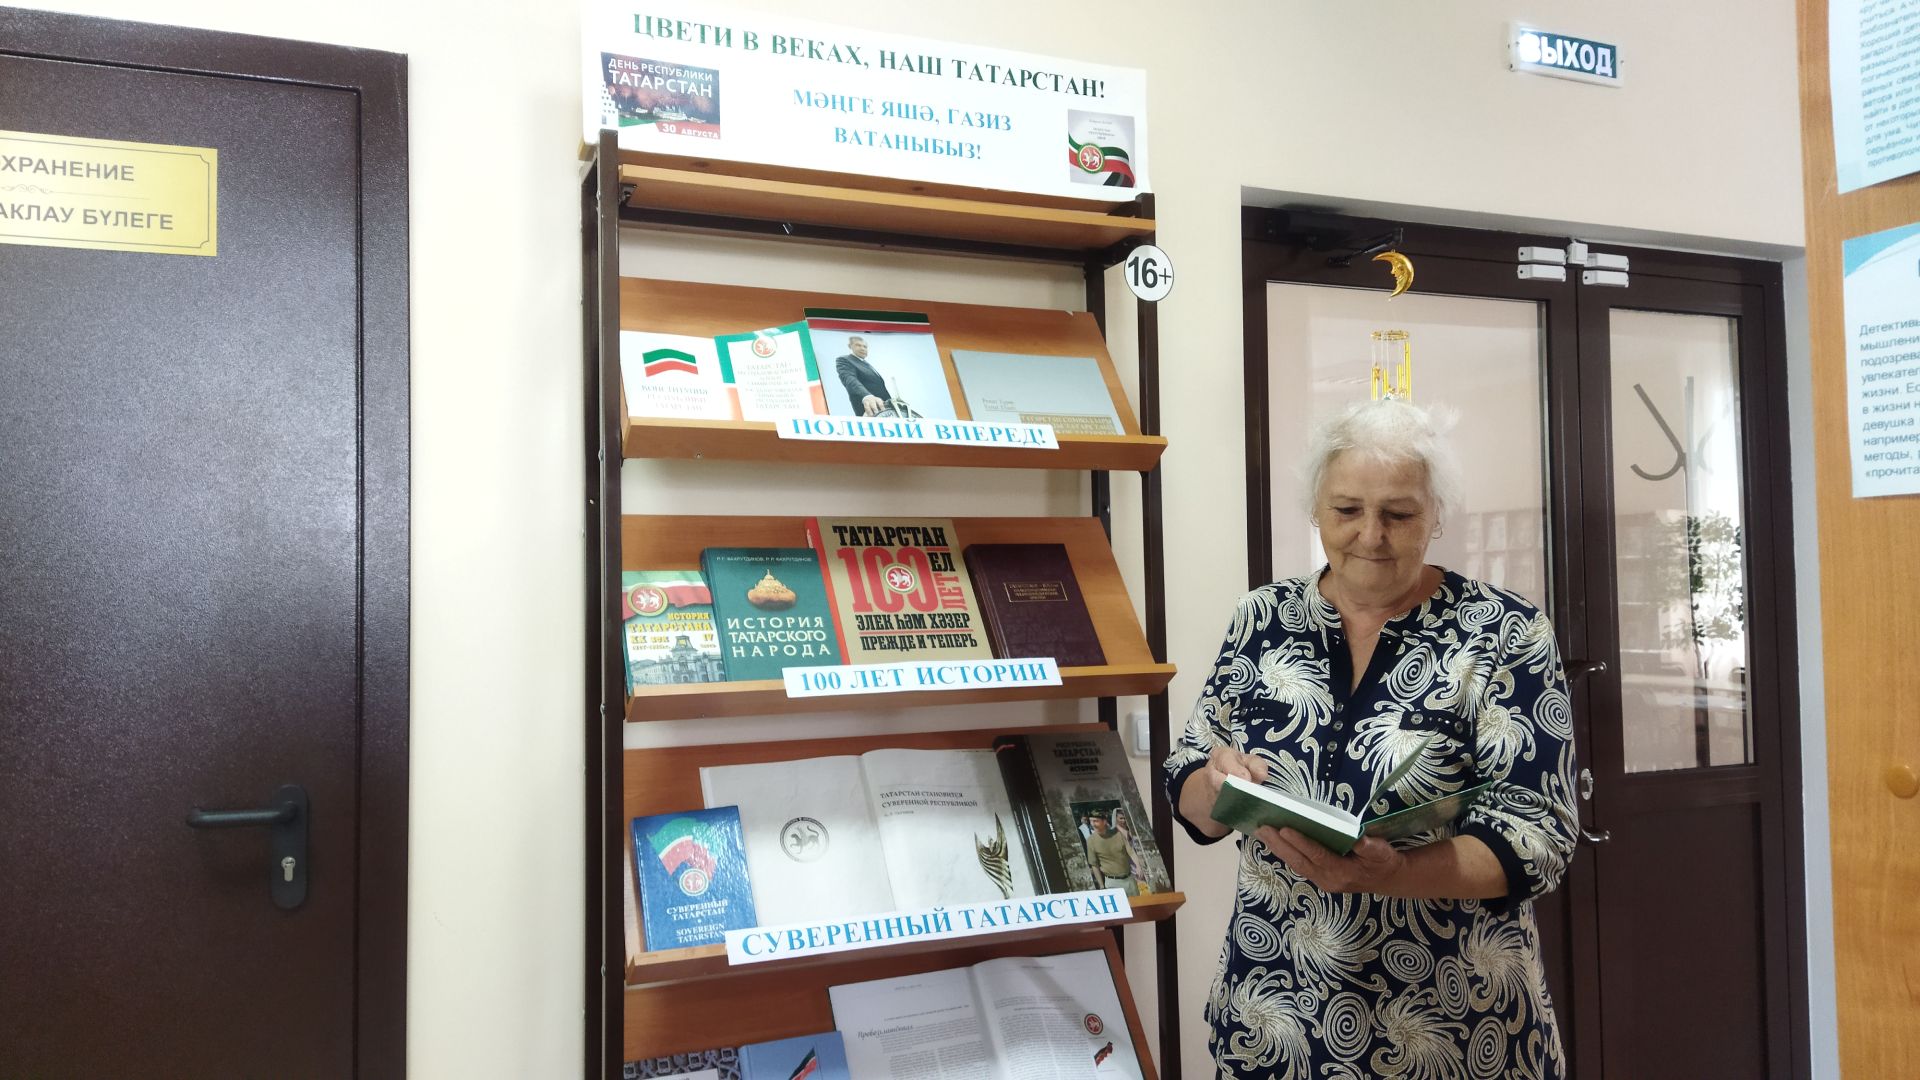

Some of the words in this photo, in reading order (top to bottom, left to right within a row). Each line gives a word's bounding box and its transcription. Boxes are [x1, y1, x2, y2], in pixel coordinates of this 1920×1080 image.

[633, 13, 733, 49] ЦВЕТИ
[743, 30, 760, 51] В
[771, 35, 870, 70] ВЕКАХ,
[879, 50, 942, 78] НАШ
[951, 59, 1106, 99] ТАТАРСТАН!
[1519, 32, 1613, 77] ВЫХОД
[608, 58, 639, 70] ДЕНЬ
[641, 63, 713, 82] РЕСПУБЛИКИ
[608, 69, 712, 98] ТАТАРСТАН
[793, 88, 874, 117] МӘҢГЕ
[881, 101, 941, 126] ЯШӘ,
[947, 107, 1013, 132] ГАЗИЗ
[662, 123, 676, 133] 30
[681, 128, 719, 139] АВГУСТА
[834, 126, 982, 161] ВАТАНЫБЫЗ!
[82, 208, 174, 231] БҮЛЕГЕ
[1127, 256, 1172, 289] 16+
[1860, 336, 1920, 351] мышлени
[1862, 406, 1869, 414] в
[1873, 401, 1911, 413] жизни
[792, 417, 924, 440] ПОЛНЫЙ
[935, 423, 1048, 446] ВПЕРЕД!
[1862, 417, 1915, 432] девушка
[832, 524, 949, 547] ТАТАРСТАН
[930, 552, 956, 572] ЕЛ
[837, 547, 942, 614] 100
[933, 573, 968, 611] ЛЕТ
[667, 612, 711, 620] ИСТОРИЯ
[727, 616, 824, 629] ИСТОРИЯ
[855, 614, 892, 631] ЭЛЕК
[896, 613, 927, 630] ҺӘМ
[930, 612, 971, 630] ХӘЗЕР
[628, 622, 714, 633] ТАТАРСТАНА
[728, 630, 826, 644] ТАТАРСКОГО
[731, 643, 831, 658] НАРОДА
[859, 634, 917, 653] ПРЕЖДЕ
[918, 633, 927, 649] И
[927, 633, 978, 649] ТЕПЕРЬ
[800, 671, 841, 692] 100
[850, 668, 905, 690] ЛЕТ
[916, 662, 1048, 686] ИСТОРИИ
[880, 790, 920, 799] ТАТАРСТАН
[881, 799, 929, 808] СУВЕРЕННОЙ
[666, 898, 728, 915] СУВЕРЕННЫЙ
[671, 907, 726, 921] ТАТАРСТАН
[676, 923, 725, 936] SOVEREIGN
[741, 906, 951, 957] СУВЕРЕННЫЙ
[958, 894, 1120, 930] ТАТАРСТАН
[678, 931, 725, 944] TATARSTAN
